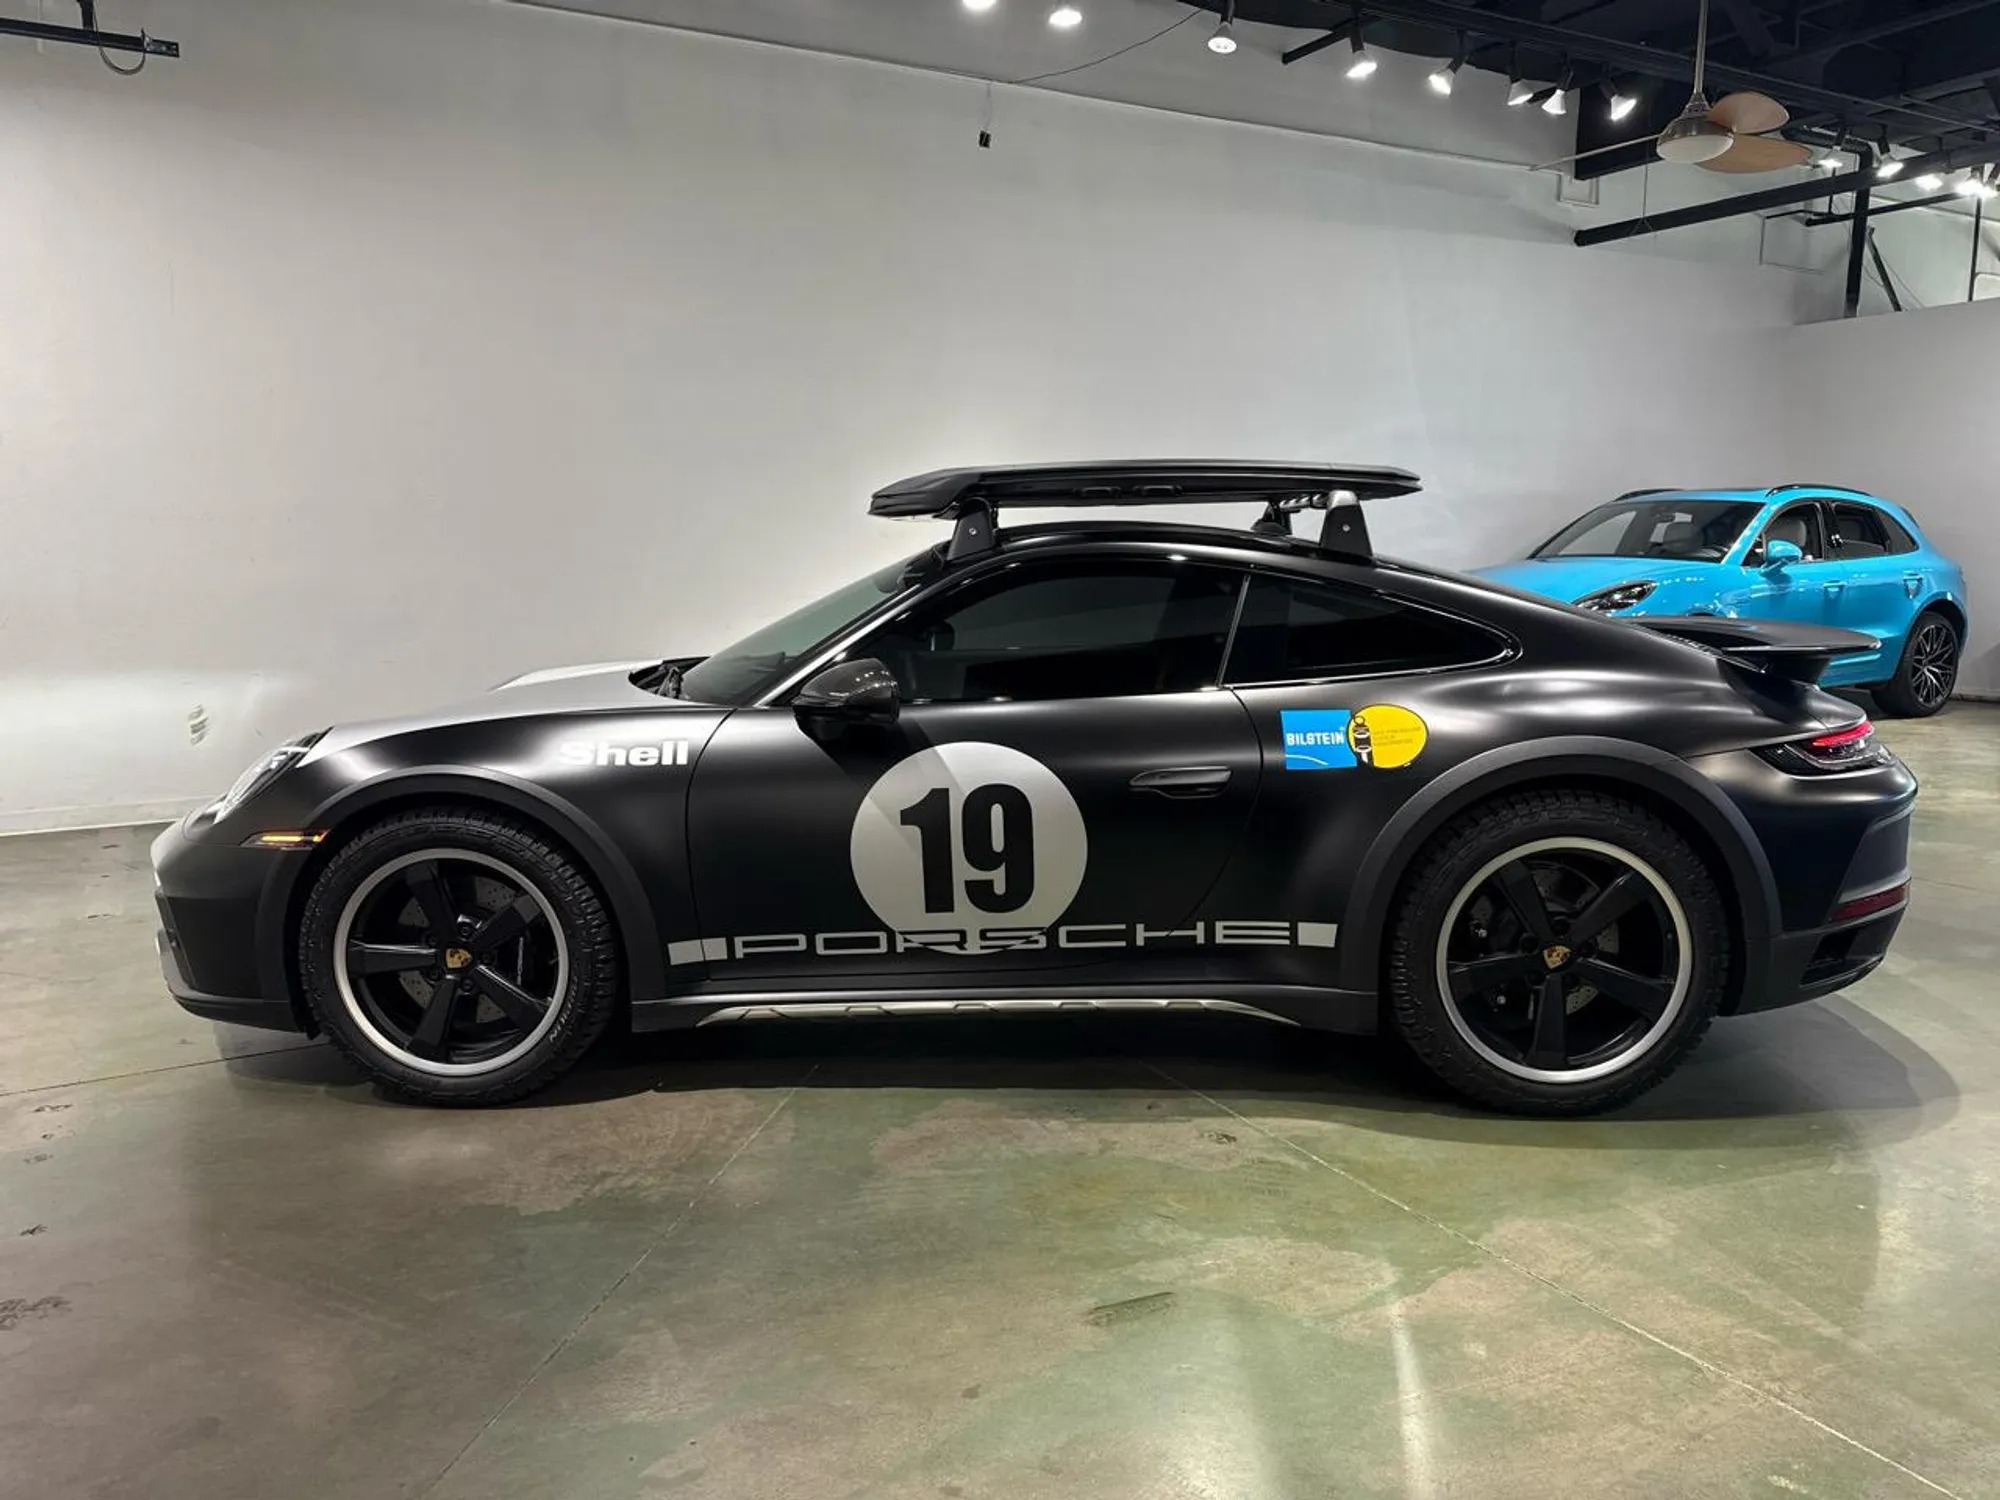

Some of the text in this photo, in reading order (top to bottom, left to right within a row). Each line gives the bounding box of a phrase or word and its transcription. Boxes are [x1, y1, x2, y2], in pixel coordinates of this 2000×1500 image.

[559, 739, 689, 767] Shell
[1286, 731, 1345, 746] BILSTEIN
[899, 782, 1035, 914] 19
[733, 920, 1291, 959] PORSCHE
